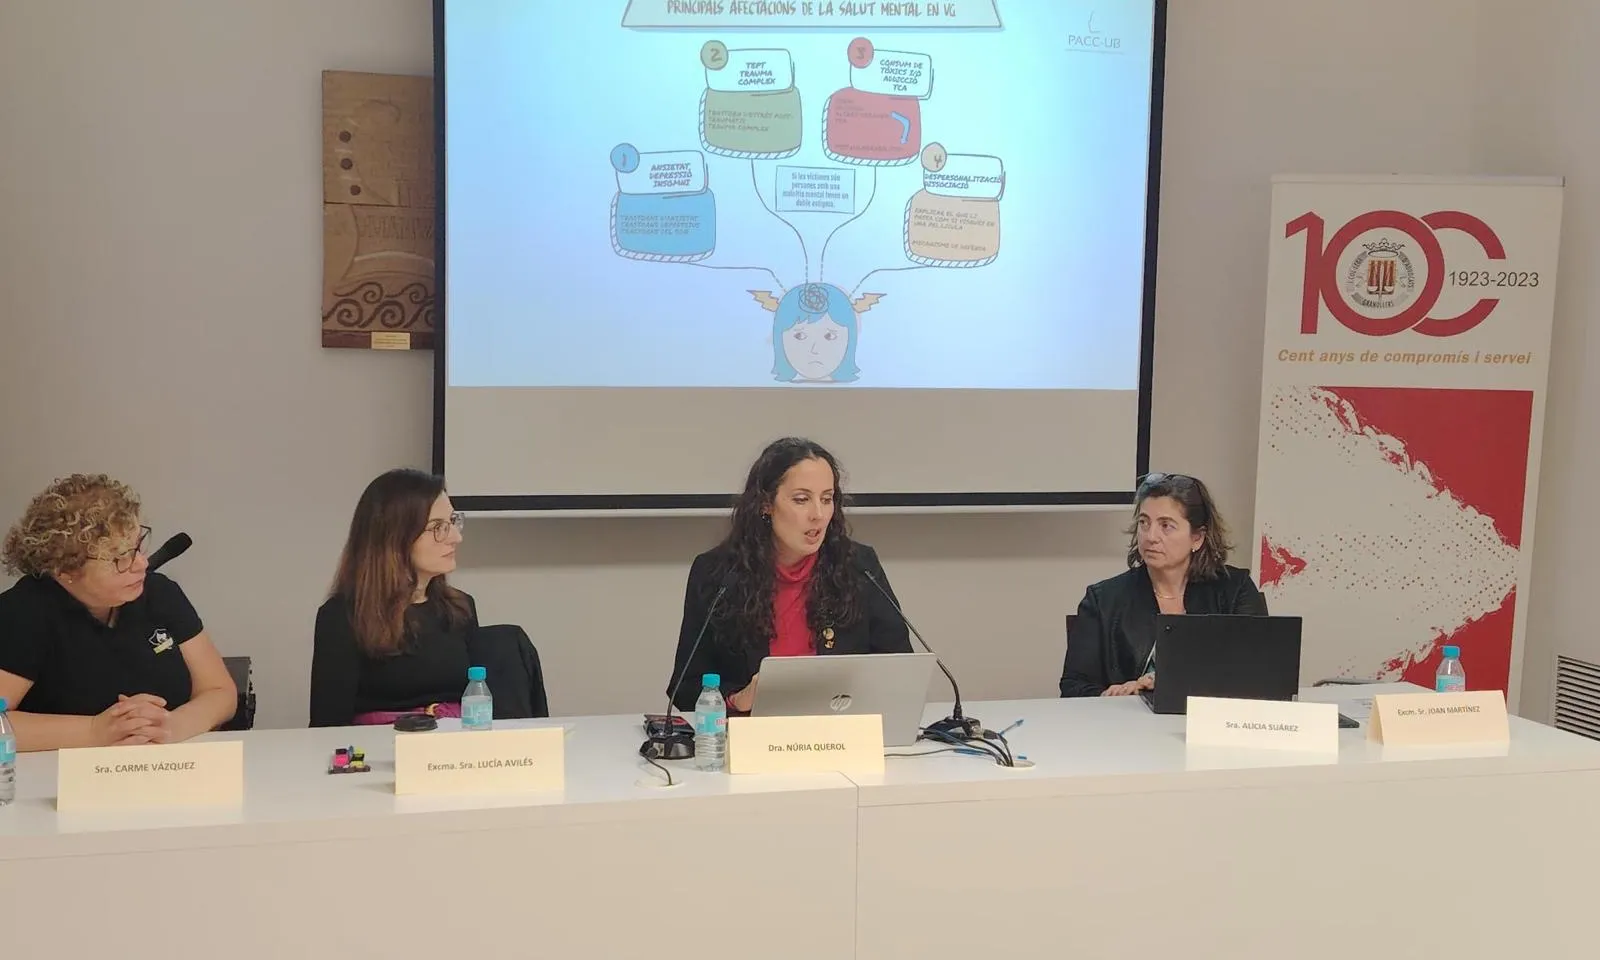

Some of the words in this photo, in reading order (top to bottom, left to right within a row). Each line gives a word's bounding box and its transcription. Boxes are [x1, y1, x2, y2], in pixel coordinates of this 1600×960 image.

[667, 0, 724, 15] PRINCIPALS
[729, 0, 796, 16] AFECTACIONS
[802, 1, 814, 16] DE
[818, 1, 834, 16] LA
[839, 1, 875, 16] SALUT
[881, 1, 922, 17] MENTAL
[927, 2, 940, 16] EN
[1068, 34, 1121, 49] PACC-UB
[710, 48, 722, 62] 2
[746, 61, 767, 69] TEPT
[880, 60, 912, 68] CONSUM
[738, 78, 776, 86] COMPLEX
[1448, 271, 1540, 288] 1923-2023
[1278, 349, 1316, 362] Cent
[1320, 350, 1355, 364] anys
[1360, 350, 1379, 362] de
[1384, 350, 1470, 365] compromís
[1483, 352, 1532, 364] servei
[1428, 706, 1446, 715] JOAN
[1447, 705, 1481, 713] MARTÍNEZ
[1225, 721, 1241, 729] Sra.
[1242, 722, 1267, 730] ALICIA
[1268, 723, 1299, 732] SUÁREZ
[768, 744, 785, 752] Dra.
[786, 742, 812, 752] NÚRIA
[813, 743, 846, 752] QUEROL
[95, 766, 112, 774] Sra.
[115, 764, 149, 773] CARME
[151, 761, 196, 772] VÁZQUEZ
[427, 762, 457, 771] Excma.
[459, 762, 476, 770] Sra.
[478, 758, 502, 769] LUCÍA
[504, 757, 533, 767] AVILÉS
